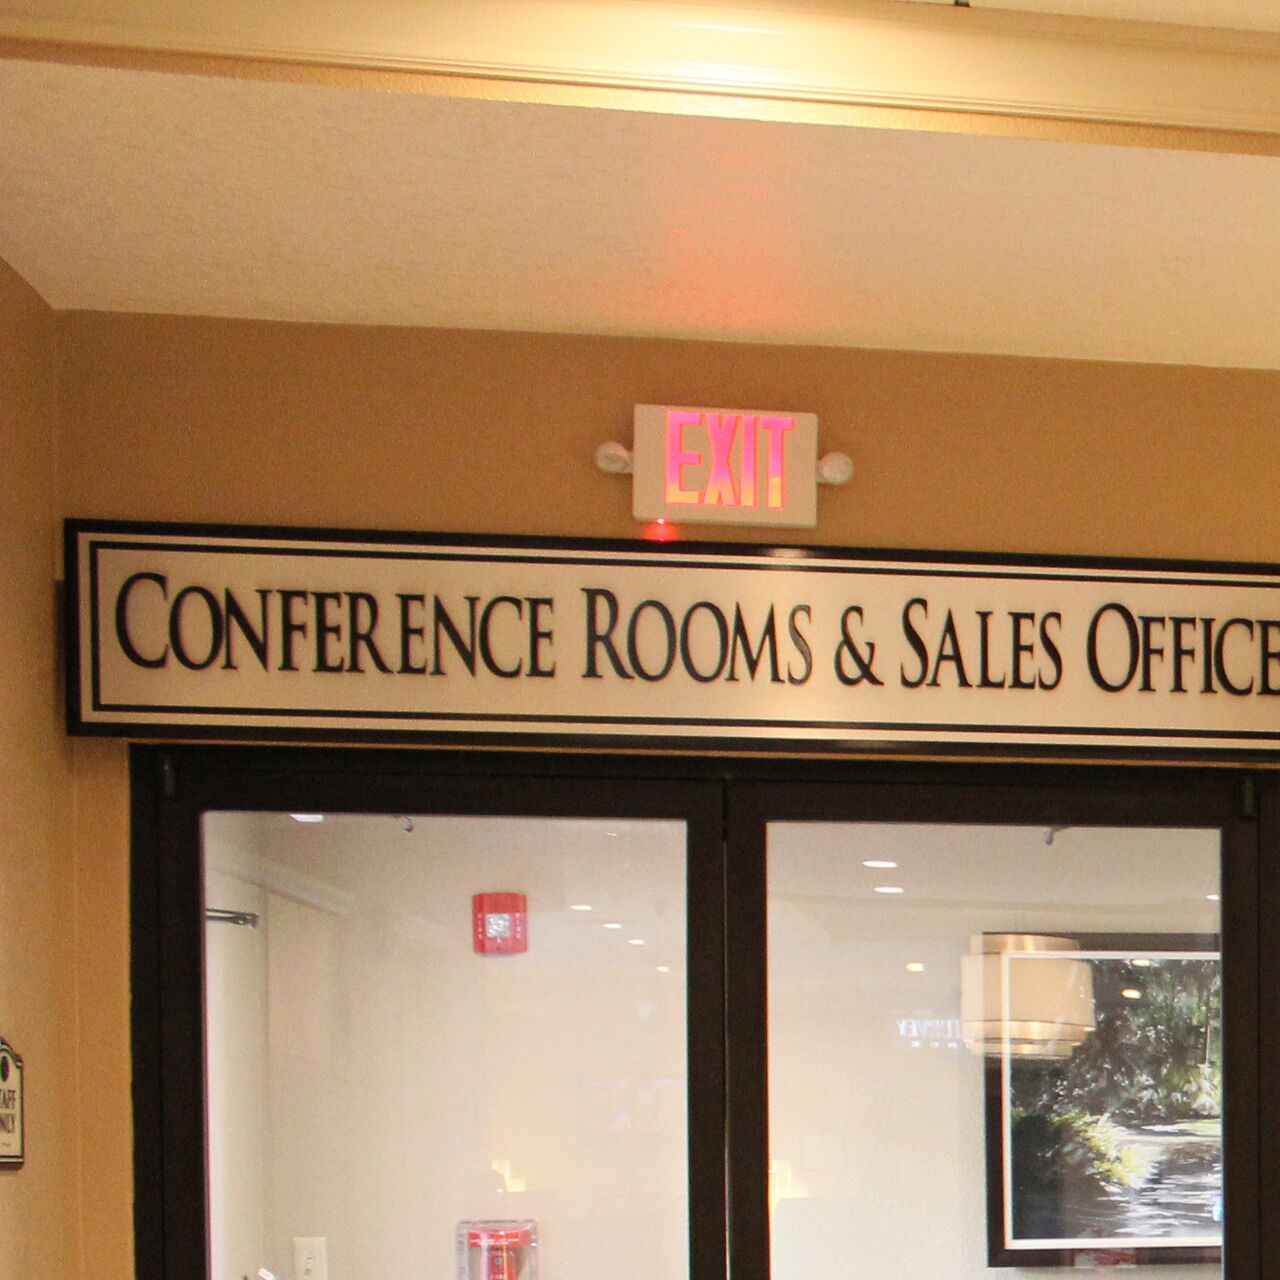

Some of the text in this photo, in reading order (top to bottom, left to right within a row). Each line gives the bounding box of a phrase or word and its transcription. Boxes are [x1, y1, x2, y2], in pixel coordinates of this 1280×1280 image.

[664, 411, 795, 511] EXIT
[115, 572, 556, 679] CONFERENCE
[581, 588, 813, 686] ROOMS
[834, 604, 885, 687] &
[900, 597, 1064, 692] SALES
